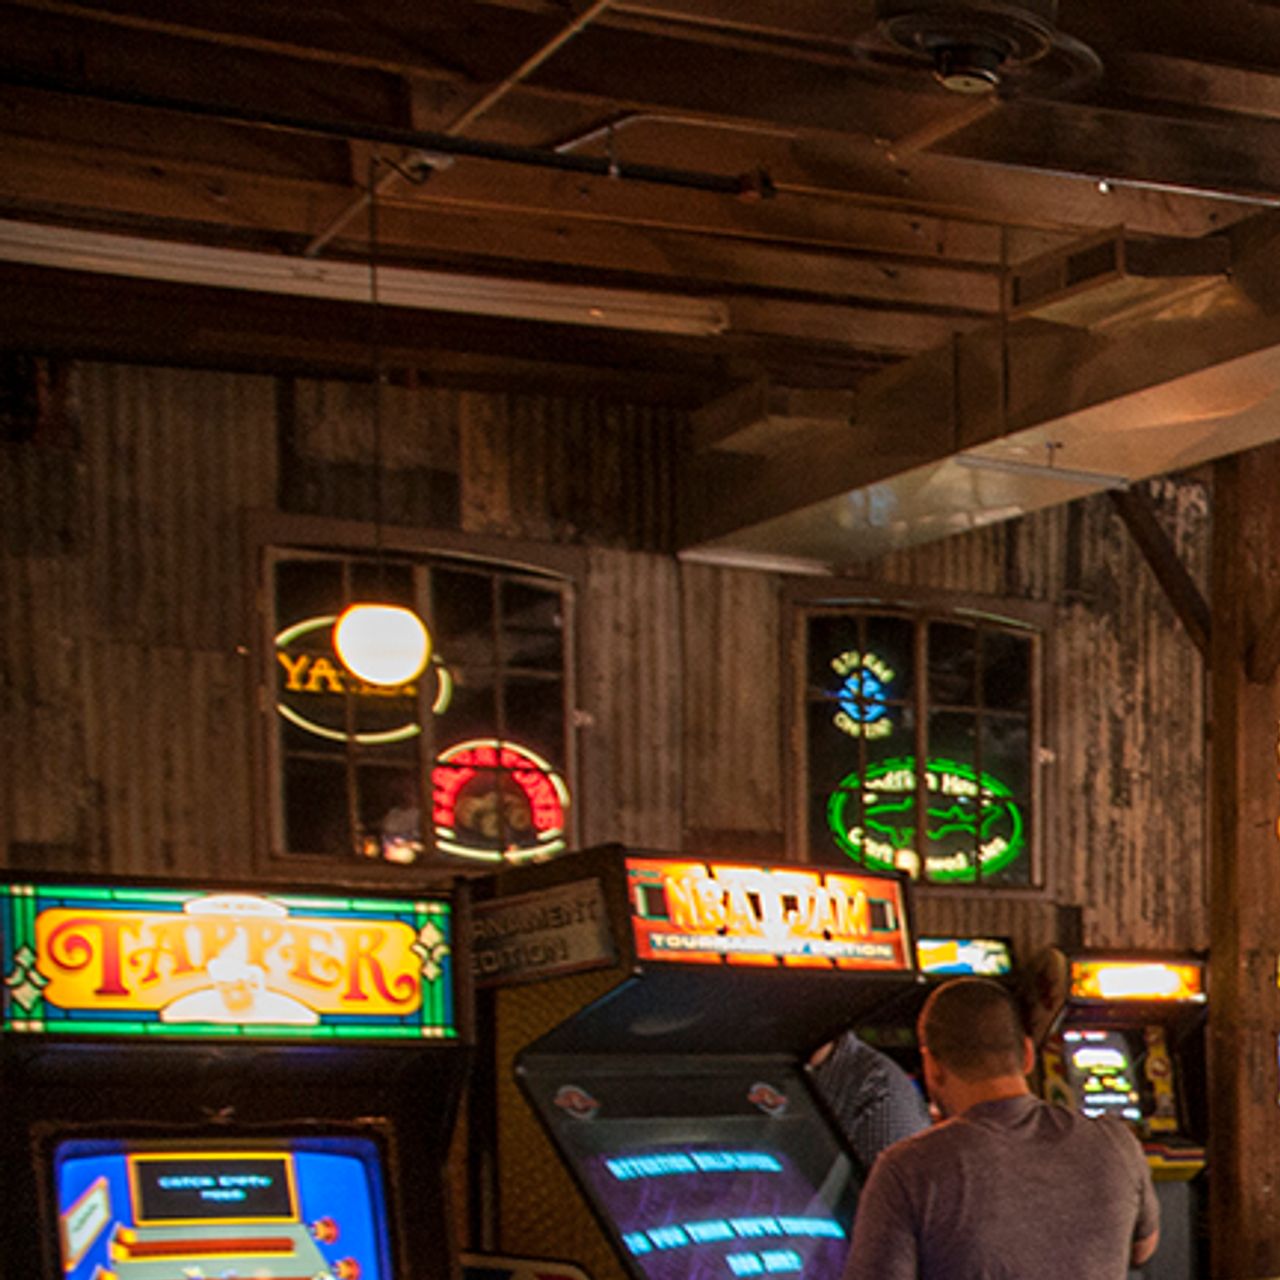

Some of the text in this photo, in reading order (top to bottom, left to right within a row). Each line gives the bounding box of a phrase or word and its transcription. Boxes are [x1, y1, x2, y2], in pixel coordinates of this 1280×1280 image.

[664, 875, 870, 934] NBA JAM
[46, 916, 422, 1005] TAPPER
